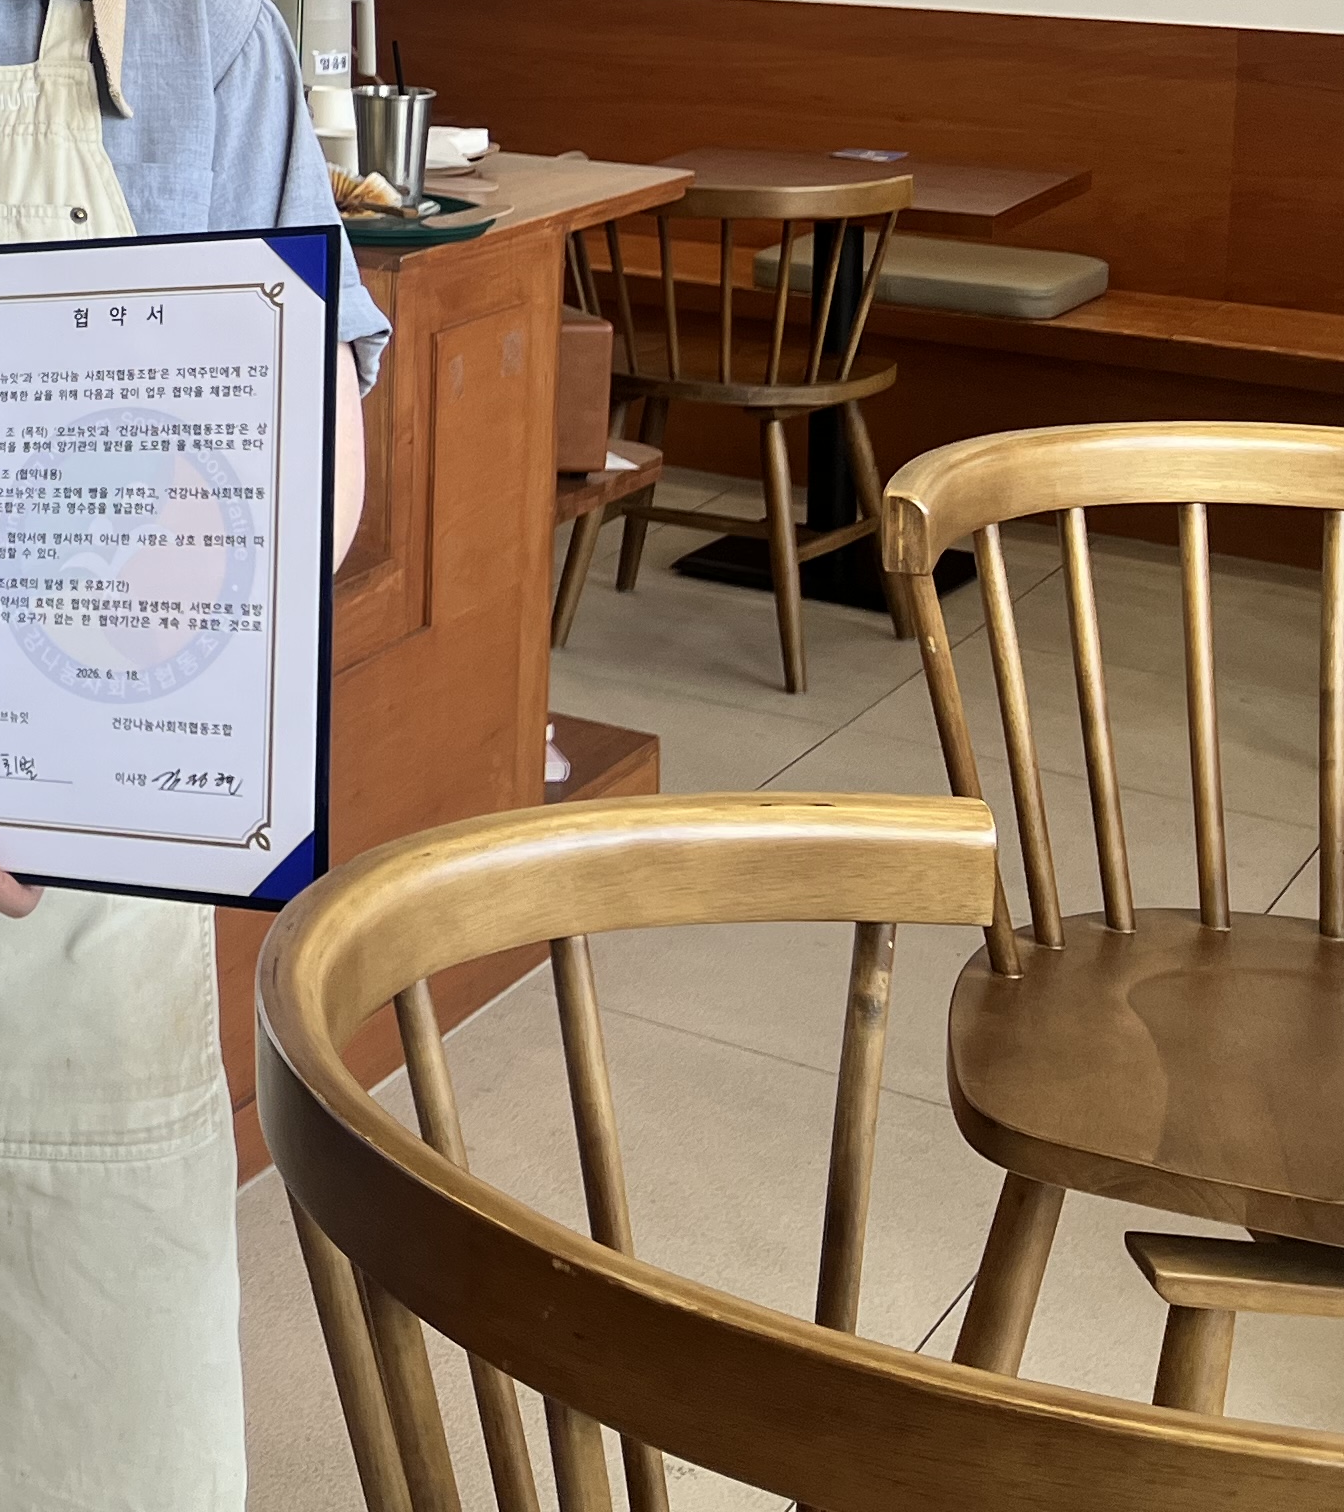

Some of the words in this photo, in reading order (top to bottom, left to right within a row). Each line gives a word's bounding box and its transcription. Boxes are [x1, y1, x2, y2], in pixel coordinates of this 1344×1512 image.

[23, 441, 52, 453] 통하여
[57, 440, 97, 453] 양기관의
[103, 440, 133, 452] 발전을
[139, 439, 171, 452] 도모함
[176, 439, 186, 451] 을
[192, 439, 235, 451] 목적으로
[241, 438, 264, 451] 한다
[31, 502, 61, 514] 기부금
[66, 502, 107, 515] 영수증을
[44, 579, 63, 591] 발생
[69, 579, 78, 592] 및
[85, 579, 130, 593] 유효기간)
[112, 717, 233, 737] 건강나눔사회적협동조합
[115, 773, 146, 786] 이사장
